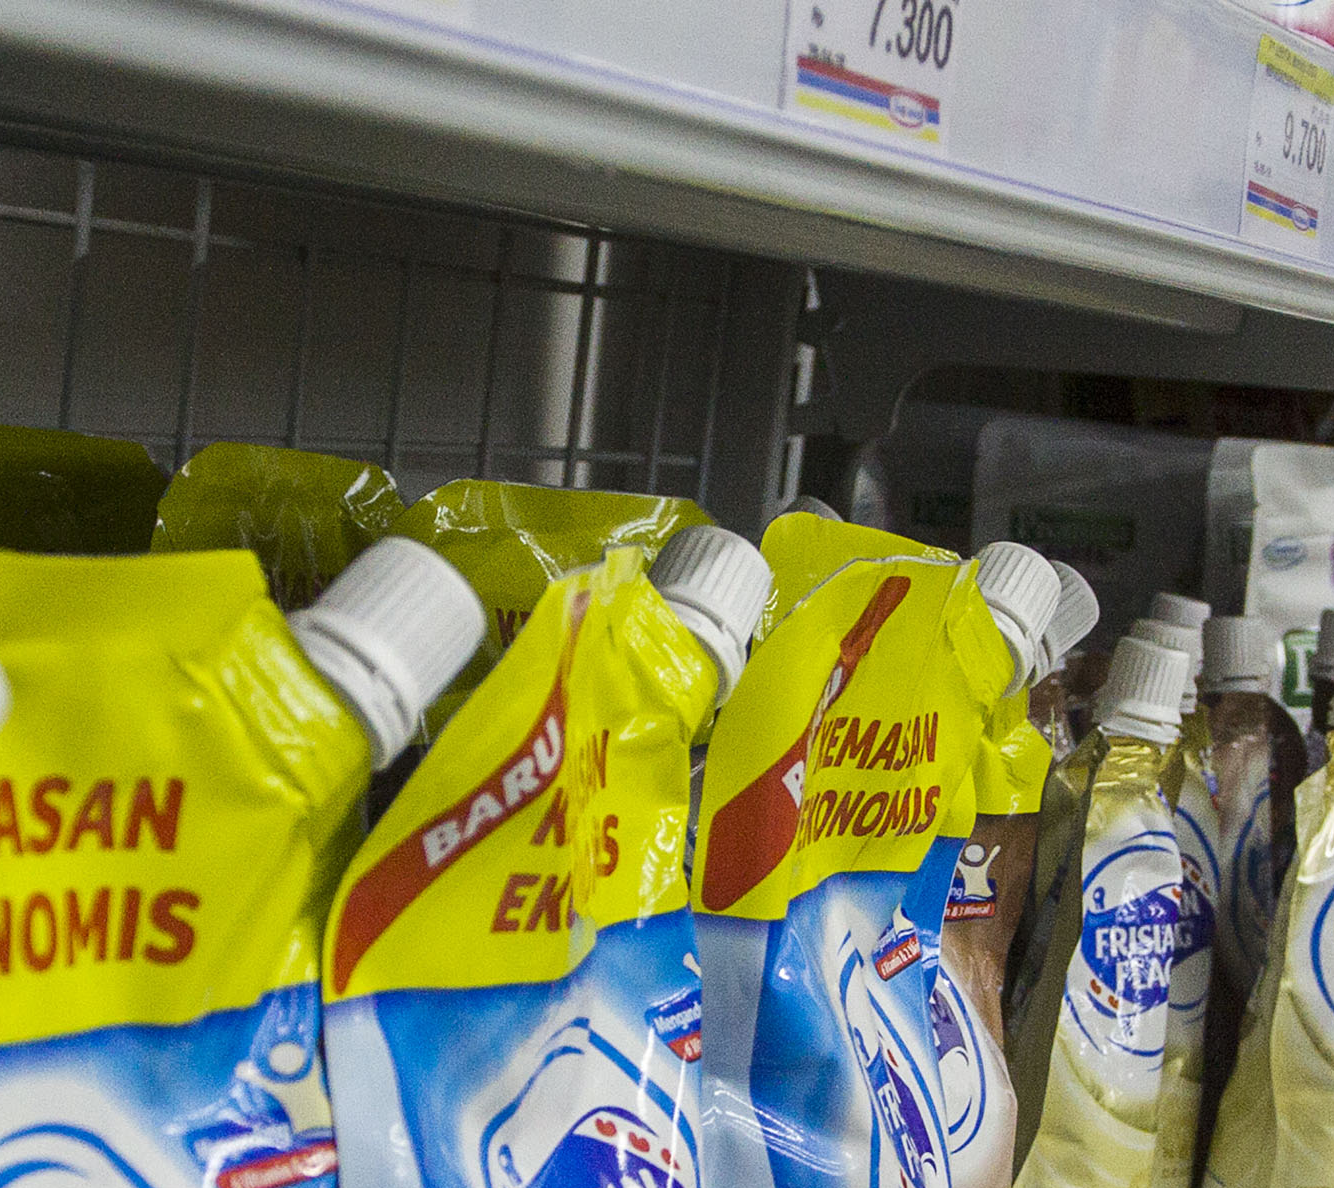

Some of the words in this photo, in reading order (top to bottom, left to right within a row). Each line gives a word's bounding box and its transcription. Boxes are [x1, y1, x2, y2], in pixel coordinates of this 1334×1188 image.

[1283, 111, 1326, 175] 9.700
[420, 715, 565, 869] BARU
[1095, 923, 1175, 960] FRISIA
